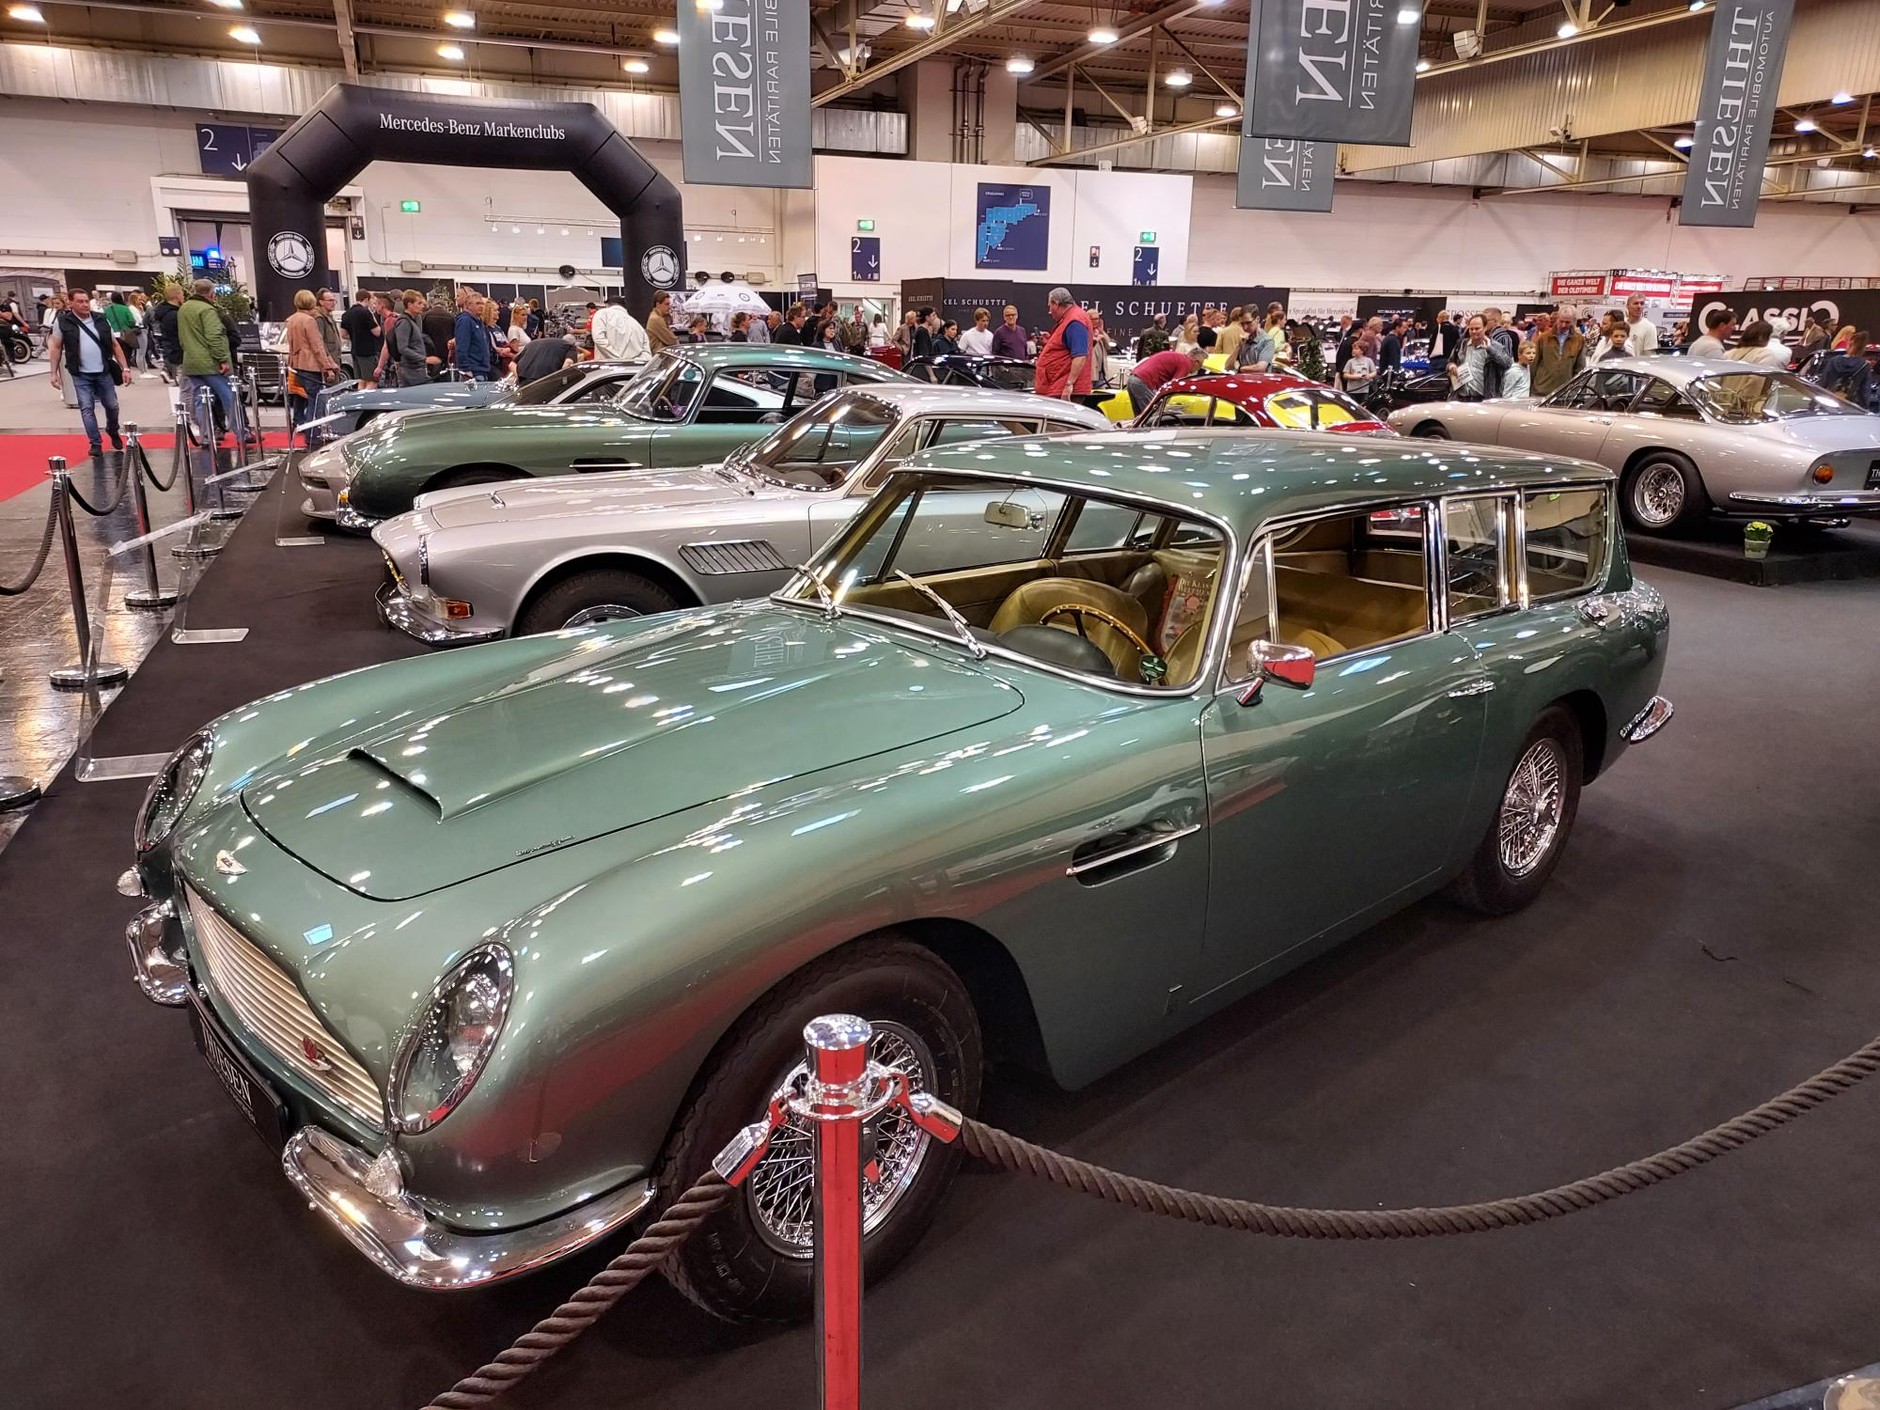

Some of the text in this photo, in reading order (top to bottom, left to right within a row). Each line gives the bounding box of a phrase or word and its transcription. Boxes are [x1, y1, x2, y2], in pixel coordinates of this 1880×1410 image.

[379, 113, 566, 140] Mercedes-Benz Markenclubs
[201, 128, 218, 151] 2
[852, 238, 862, 253] 2
[1134, 247, 1143, 261] 2
